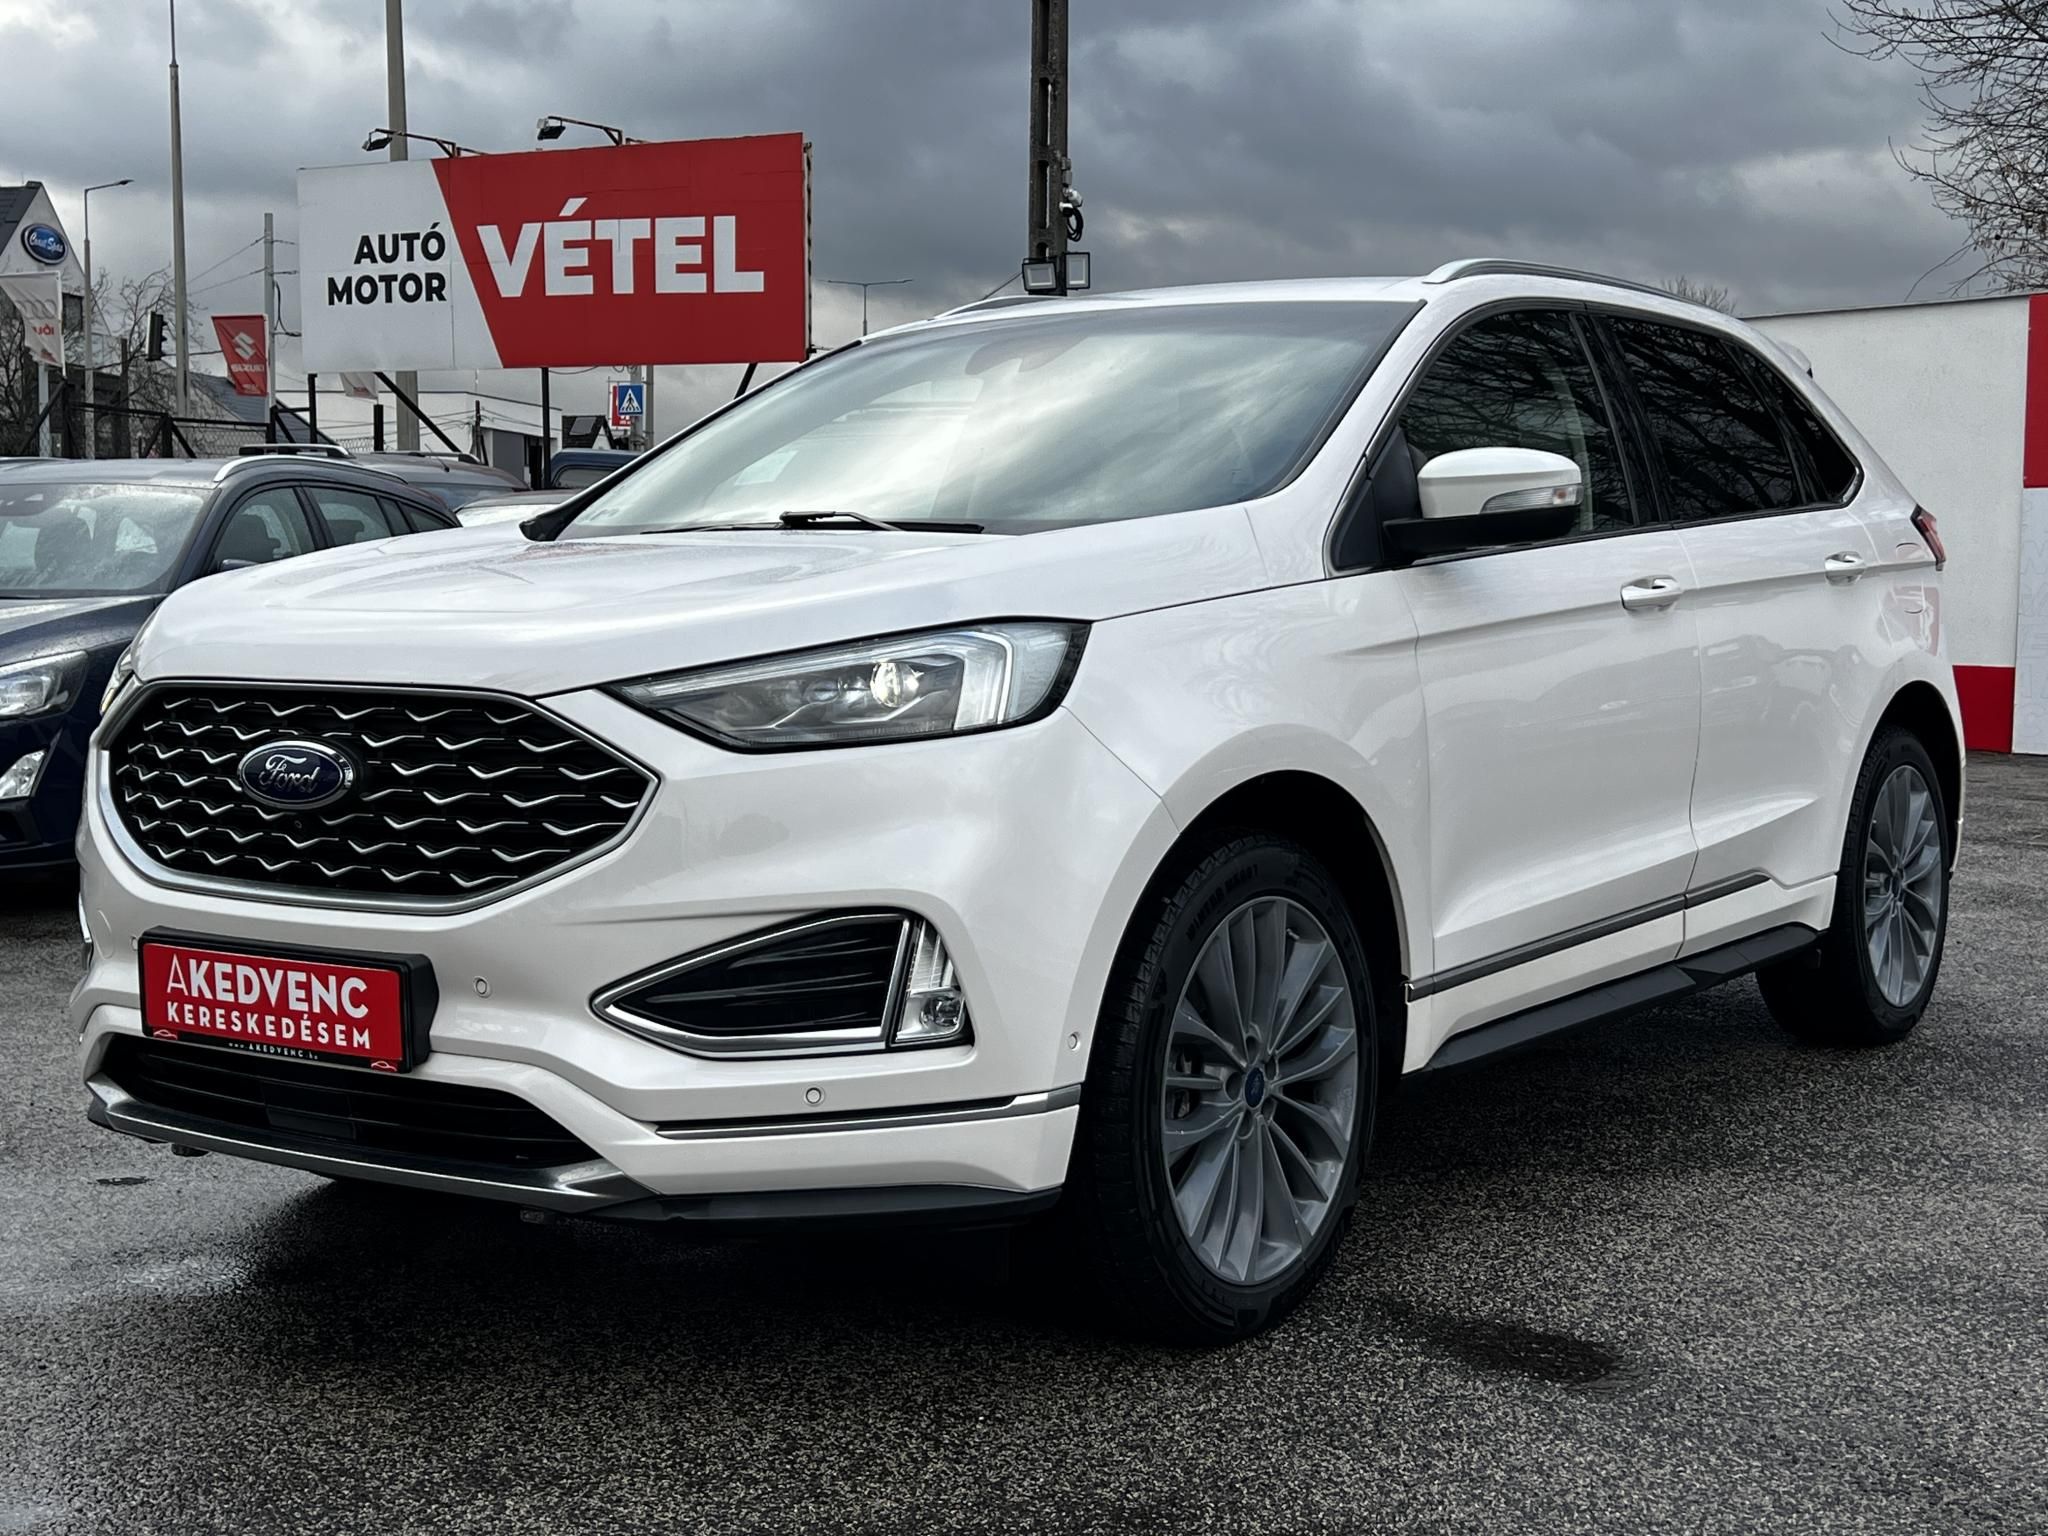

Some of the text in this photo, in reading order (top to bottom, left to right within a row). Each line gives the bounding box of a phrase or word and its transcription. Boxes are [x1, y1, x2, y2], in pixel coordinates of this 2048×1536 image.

[354, 222, 446, 265] AUTÓ
[476, 197, 765, 298] VÉTEL
[327, 272, 447, 306] MOTOR
[230, 363, 265, 373] SUZUKI
[258, 753, 321, 793] Ford
[167, 1001, 371, 1049] KERESKEDÉSEM
